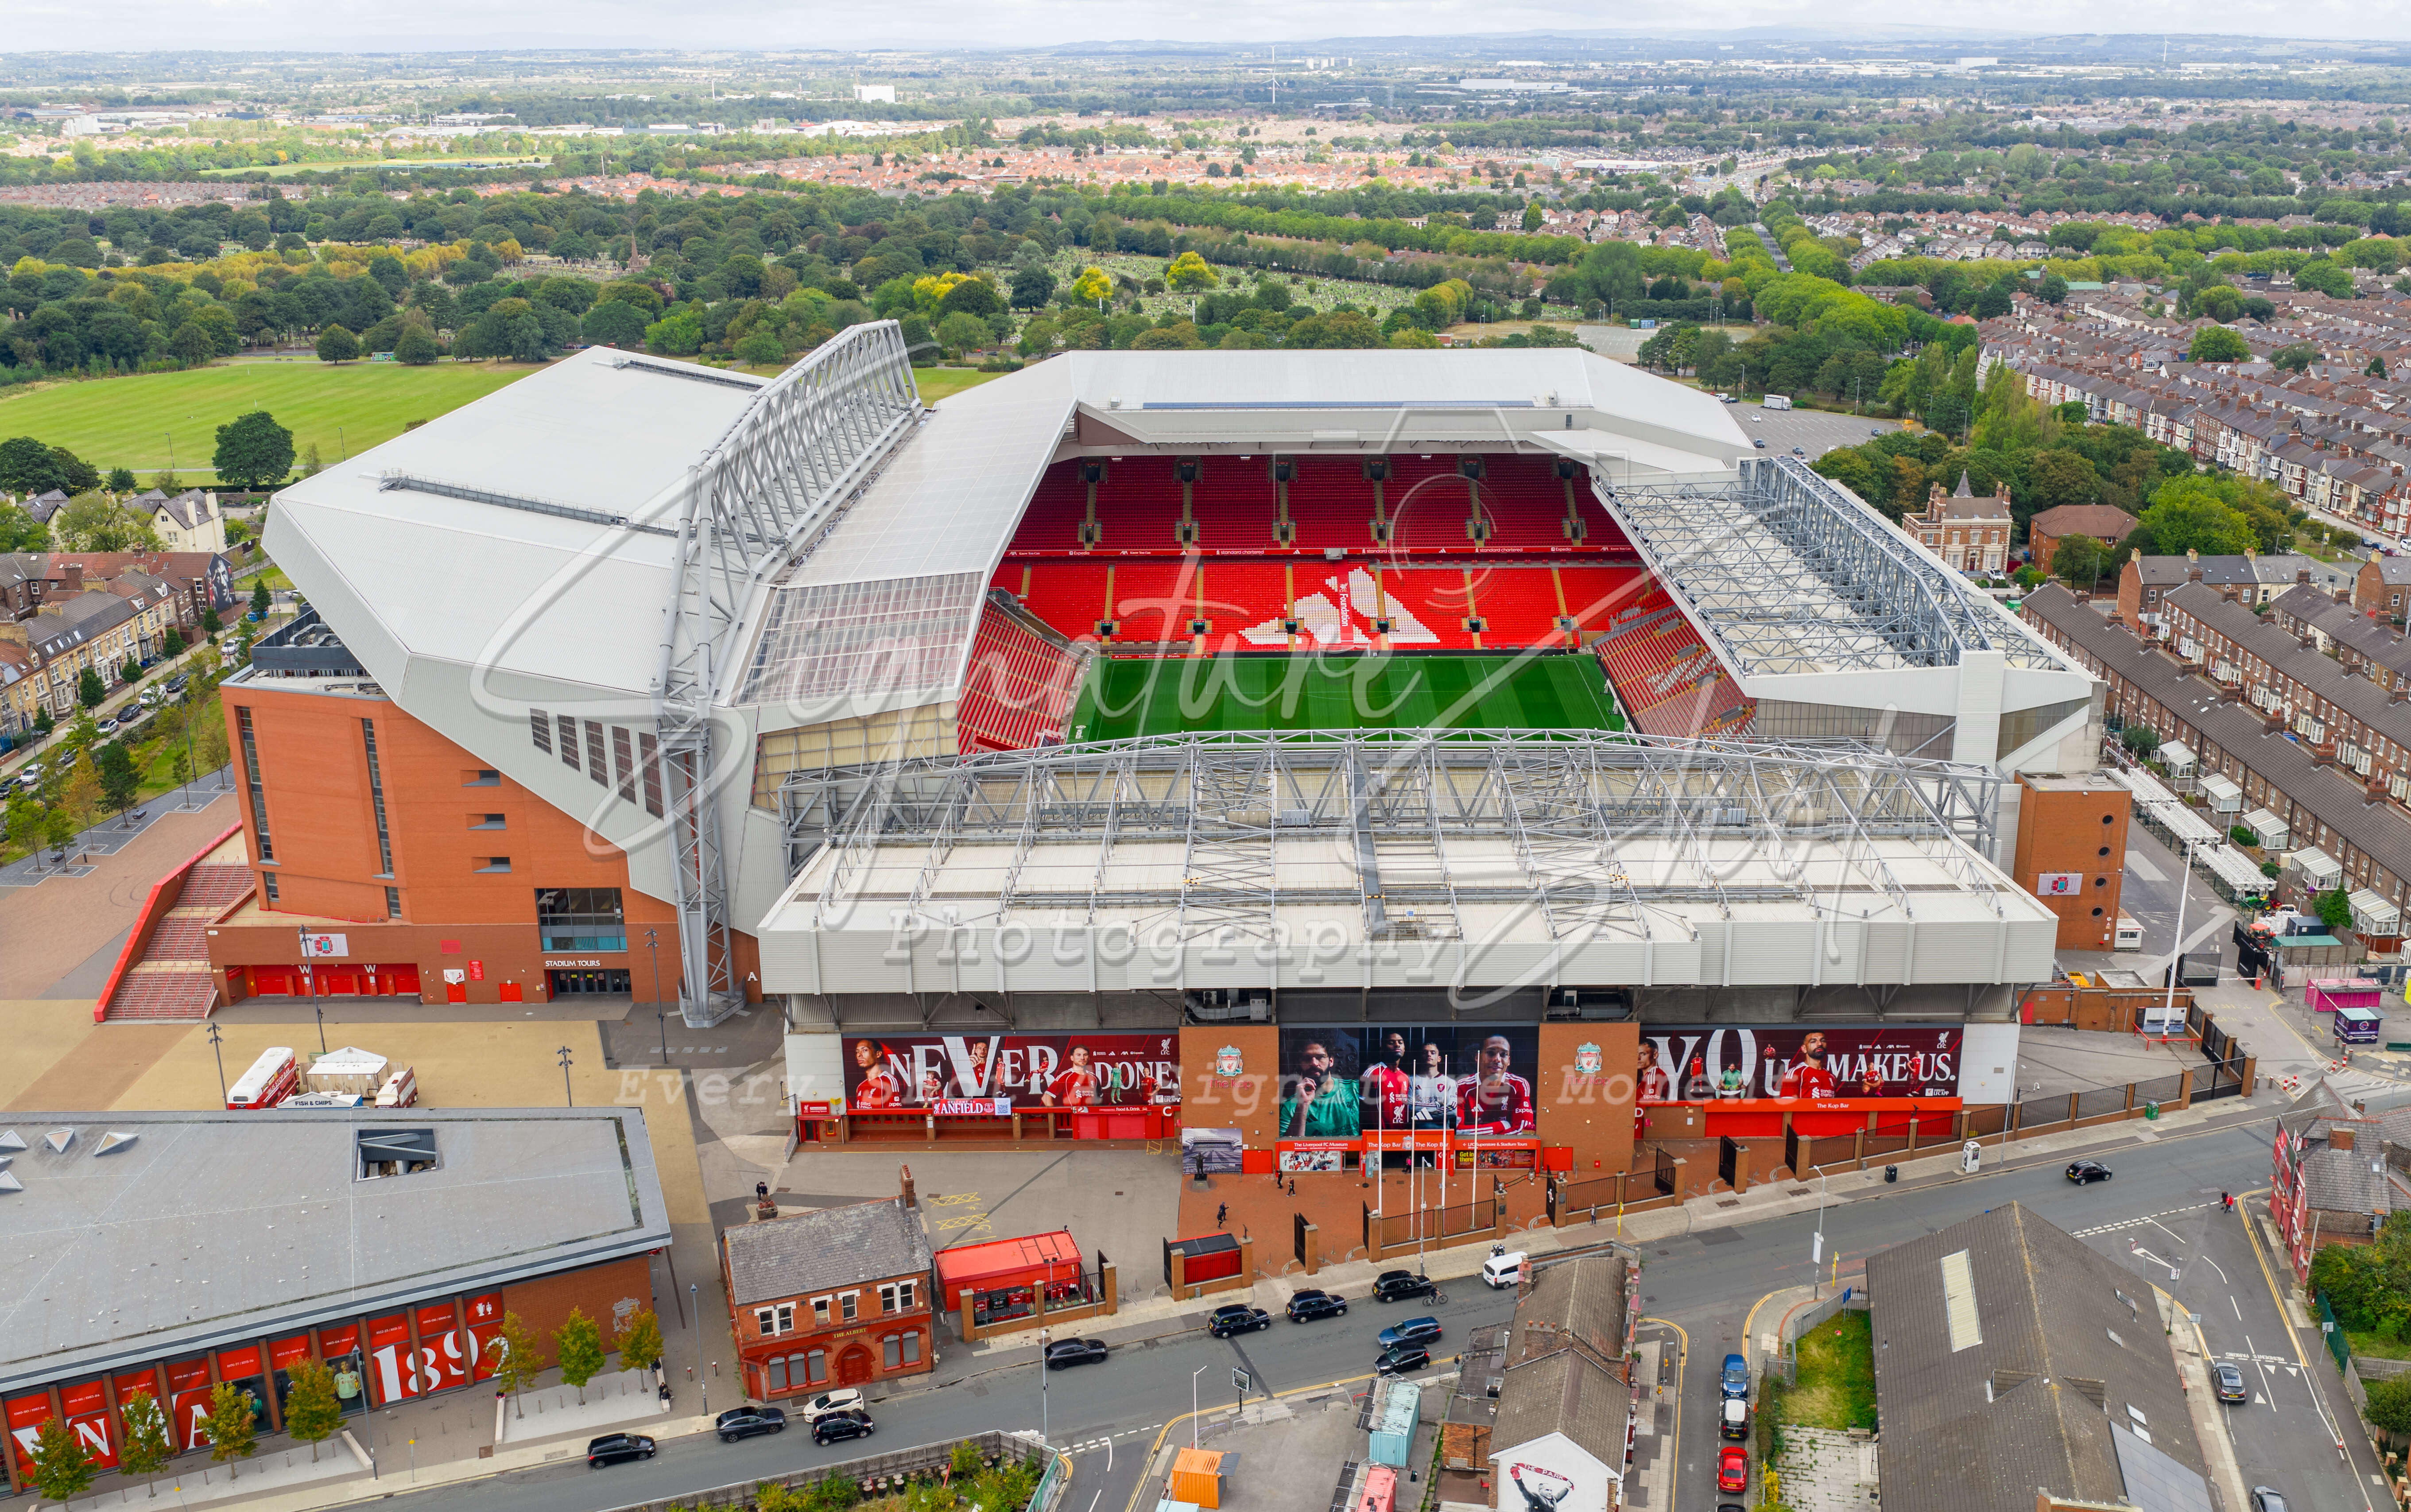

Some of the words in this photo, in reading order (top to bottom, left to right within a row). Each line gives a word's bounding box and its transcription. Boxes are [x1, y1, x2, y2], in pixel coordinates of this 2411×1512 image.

[1339, 593, 1350, 627] Foundation
[298, 965, 310, 974] W
[364, 965, 376, 973] W
[747, 972, 758, 981] A
[888, 1036, 1059, 1102] NEVER
[1094, 1061, 1179, 1090] DONE.
[1646, 1029, 1791, 1101] YOU
[1827, 1054, 1909, 1082] MAKE
[1918, 1053, 1956, 1082] US.
[274, 1078, 285, 1089] STOP
[1208, 1078, 1229, 1088] The
[1231, 1078, 1253, 1090] Kop
[1566, 1075, 1587, 1085] The
[1589, 1075, 1610, 1087] Kop
[941, 1103, 983, 1114] ANFIELD
[1163, 1106, 1173, 1117] C
[1635, 1107, 1644, 1117] D
[845, 1327, 867, 1336] ALBERT
[1523, 1463, 1536, 1472] THE
[1542, 1469, 1564, 1481] PARK
